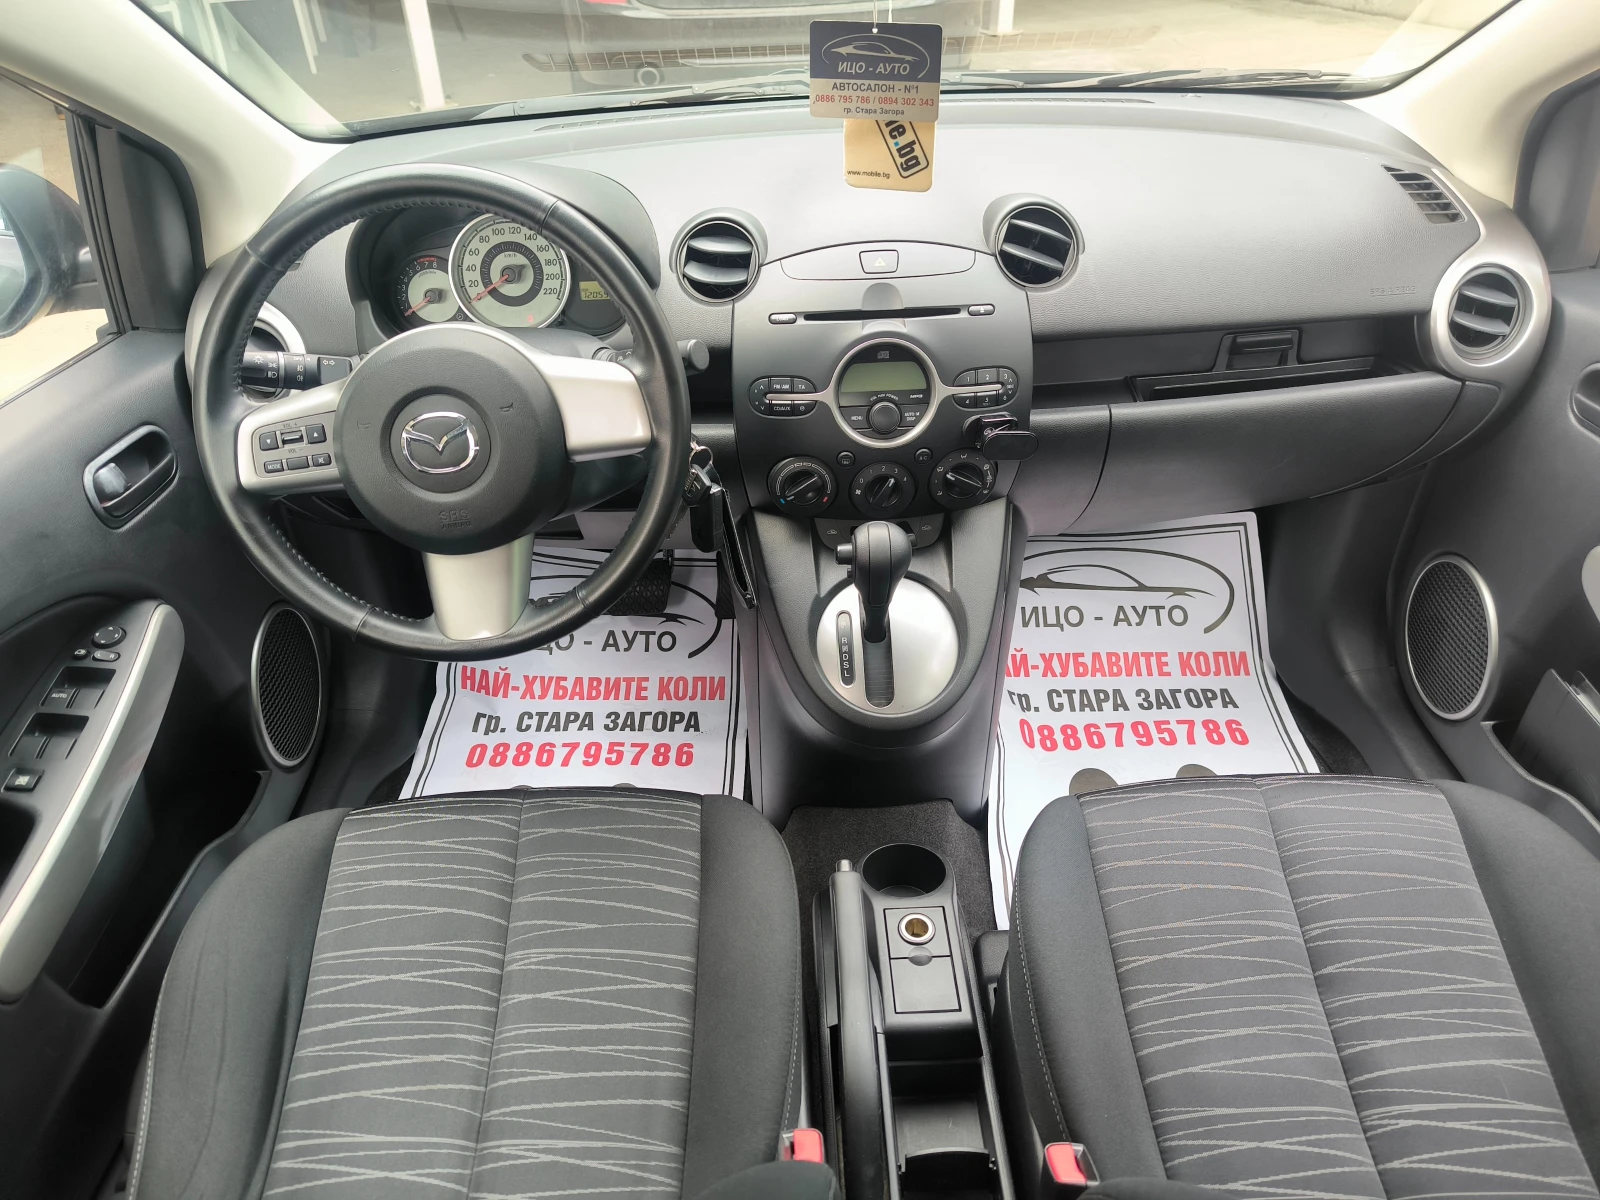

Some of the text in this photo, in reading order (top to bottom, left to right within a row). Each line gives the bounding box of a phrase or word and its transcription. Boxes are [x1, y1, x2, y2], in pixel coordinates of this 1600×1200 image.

[838, 62, 866, 74] ИЦО
[876, 63, 910, 75] АУТО
[832, 82, 895, 93] АВТОСАЛОН
[838, 95, 853, 104] 795
[856, 96, 870, 104] 786
[878, 96, 898, 105] 0894
[901, 97, 916, 106] 302
[919, 98, 934, 107] 343
[855, 106, 878, 116] Стара
[879, 107, 905, 116] Загора
[846, 170, 890, 180] www.mobile.bg
[492, 228, 505, 236] 100
[508, 226, 522, 234] 120
[479, 236, 490, 244] 80
[468, 248, 480, 256] 60
[536, 244, 550, 252] 160
[466, 264, 477, 272] 40
[468, 280, 479, 288] 20
[1021, 605, 1084, 632] ИЦО
[1113, 604, 1189, 627] АУТО
[601, 630, 677, 652] АУТО
[1178, 651, 1251, 677] КОЛИ
[461, 665, 726, 700] НАЙ-ХУБАВИТЕ КОЛИ
[1047, 688, 1130, 712] СТАРА
[1135, 688, 1239, 710] ЗАГОРА
[516, 712, 594, 732] СТАРА
[603, 711, 700, 733] ЗАГОРА
[1019, 718, 1249, 752] 0886795786
[465, 742, 694, 768] 0886795786
